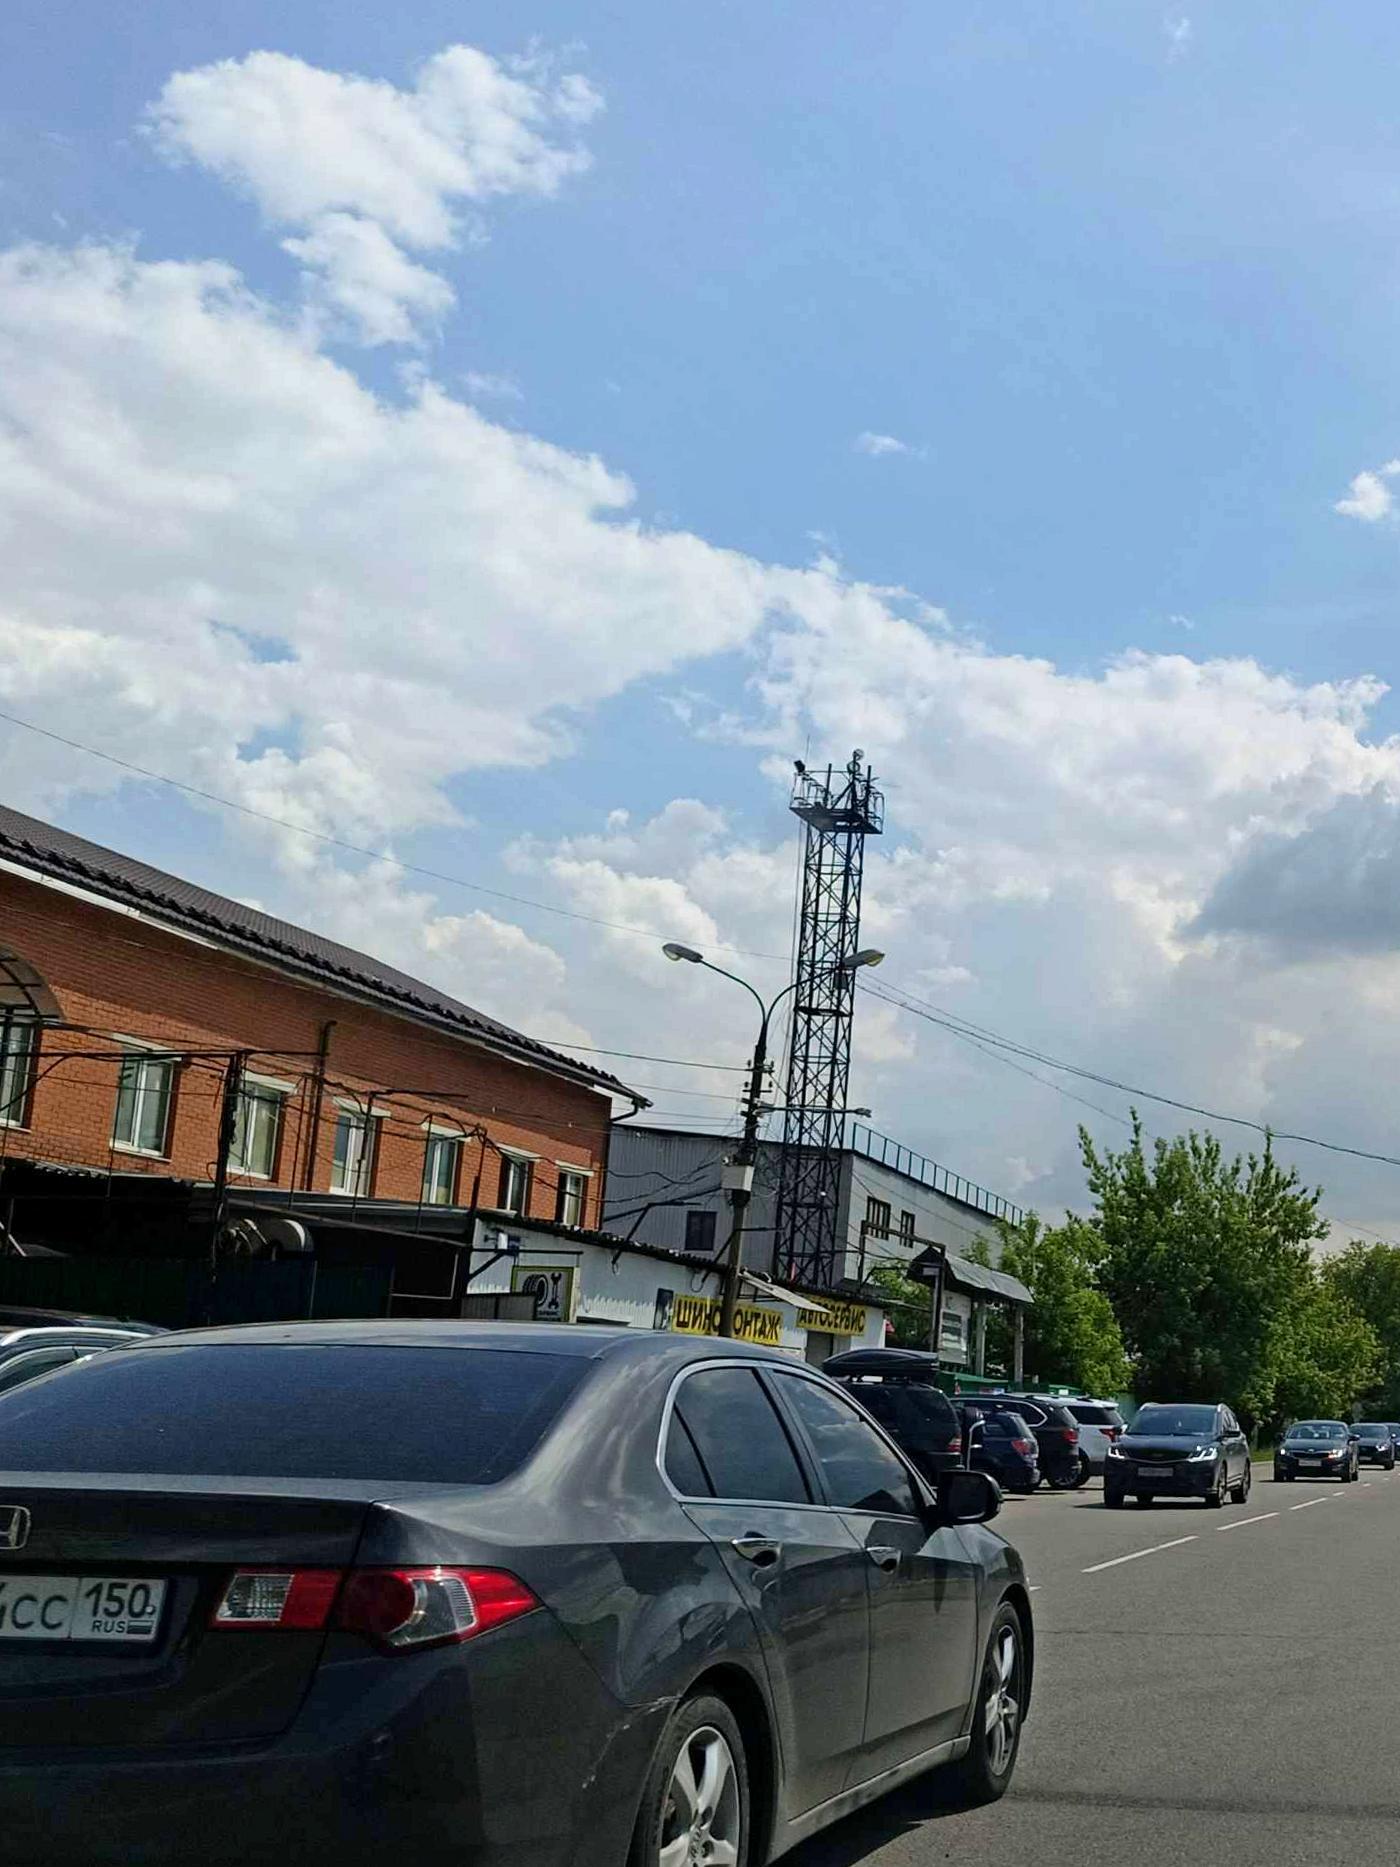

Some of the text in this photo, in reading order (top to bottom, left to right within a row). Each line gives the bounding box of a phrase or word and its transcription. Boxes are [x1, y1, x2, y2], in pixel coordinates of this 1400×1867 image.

[676, 1298, 782, 1342] ШИНООНТАЖ
[0, 1581, 150, 1629] СС 150
[91, 1620, 126, 1633] RUS
